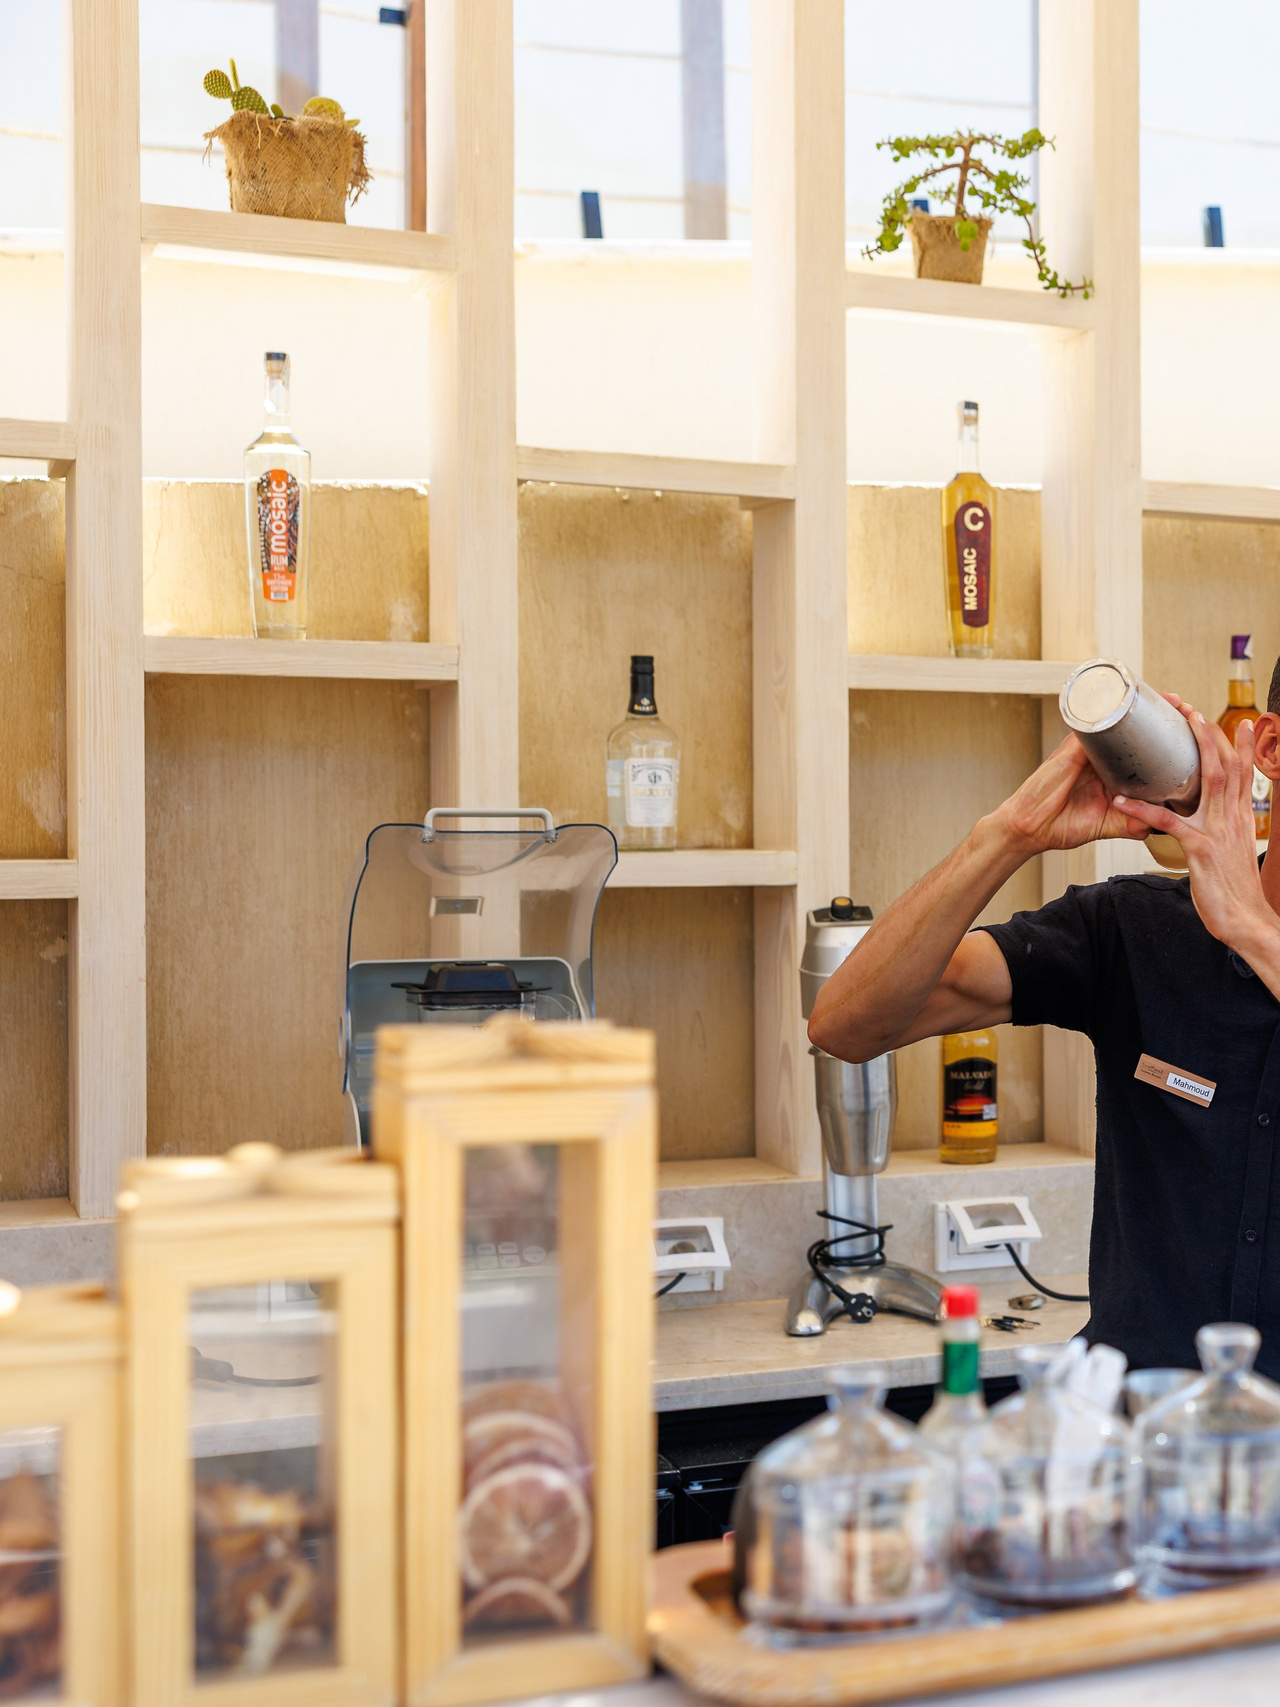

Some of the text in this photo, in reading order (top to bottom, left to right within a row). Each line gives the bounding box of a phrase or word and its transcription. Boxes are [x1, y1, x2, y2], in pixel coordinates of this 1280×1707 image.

[271, 480, 287, 553] mosaic
[964, 507, 984, 531] C
[270, 554, 288, 566] RUM
[963, 547, 977, 610] MOSAIC
[950, 1071, 993, 1079] MALVAD
[1172, 1077, 1210, 1097] Mahmoud
